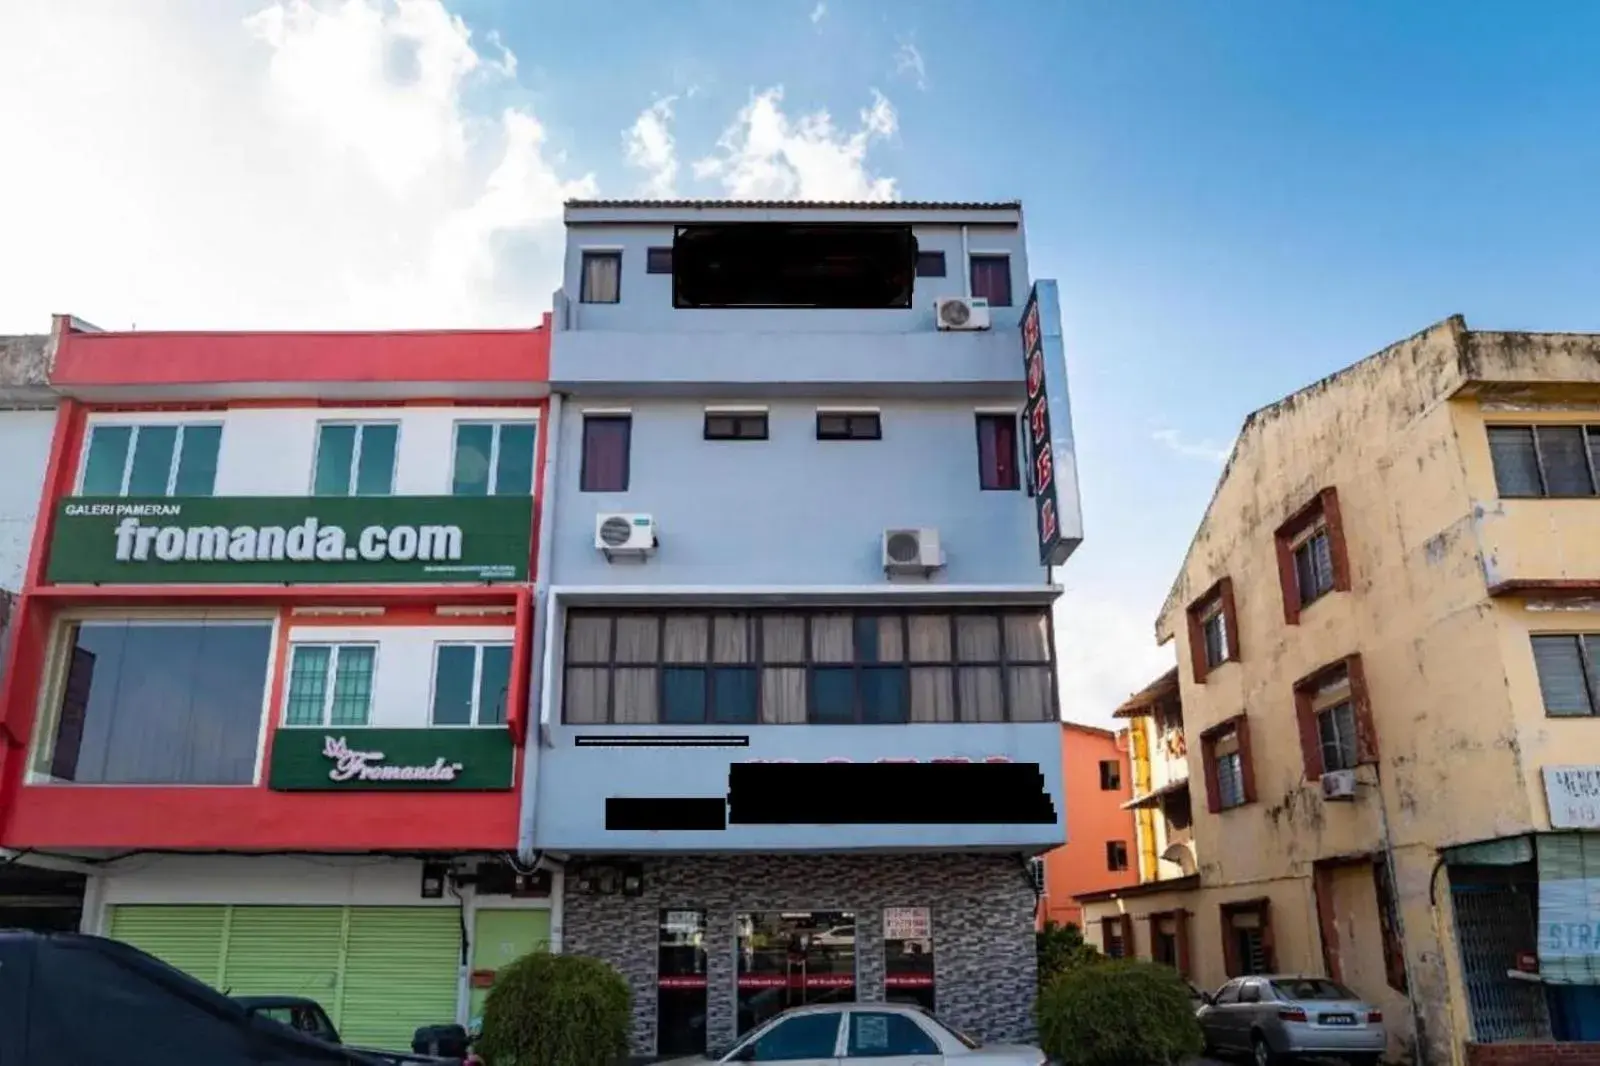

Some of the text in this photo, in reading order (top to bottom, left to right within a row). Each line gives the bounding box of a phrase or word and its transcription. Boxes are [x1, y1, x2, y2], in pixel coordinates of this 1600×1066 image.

[1023, 301, 1056, 544] HOTEL
[65, 504, 181, 515] GALERI PAMERAN
[114, 516, 463, 562] fromanda.com
[328, 751, 456, 781] Fromanda
